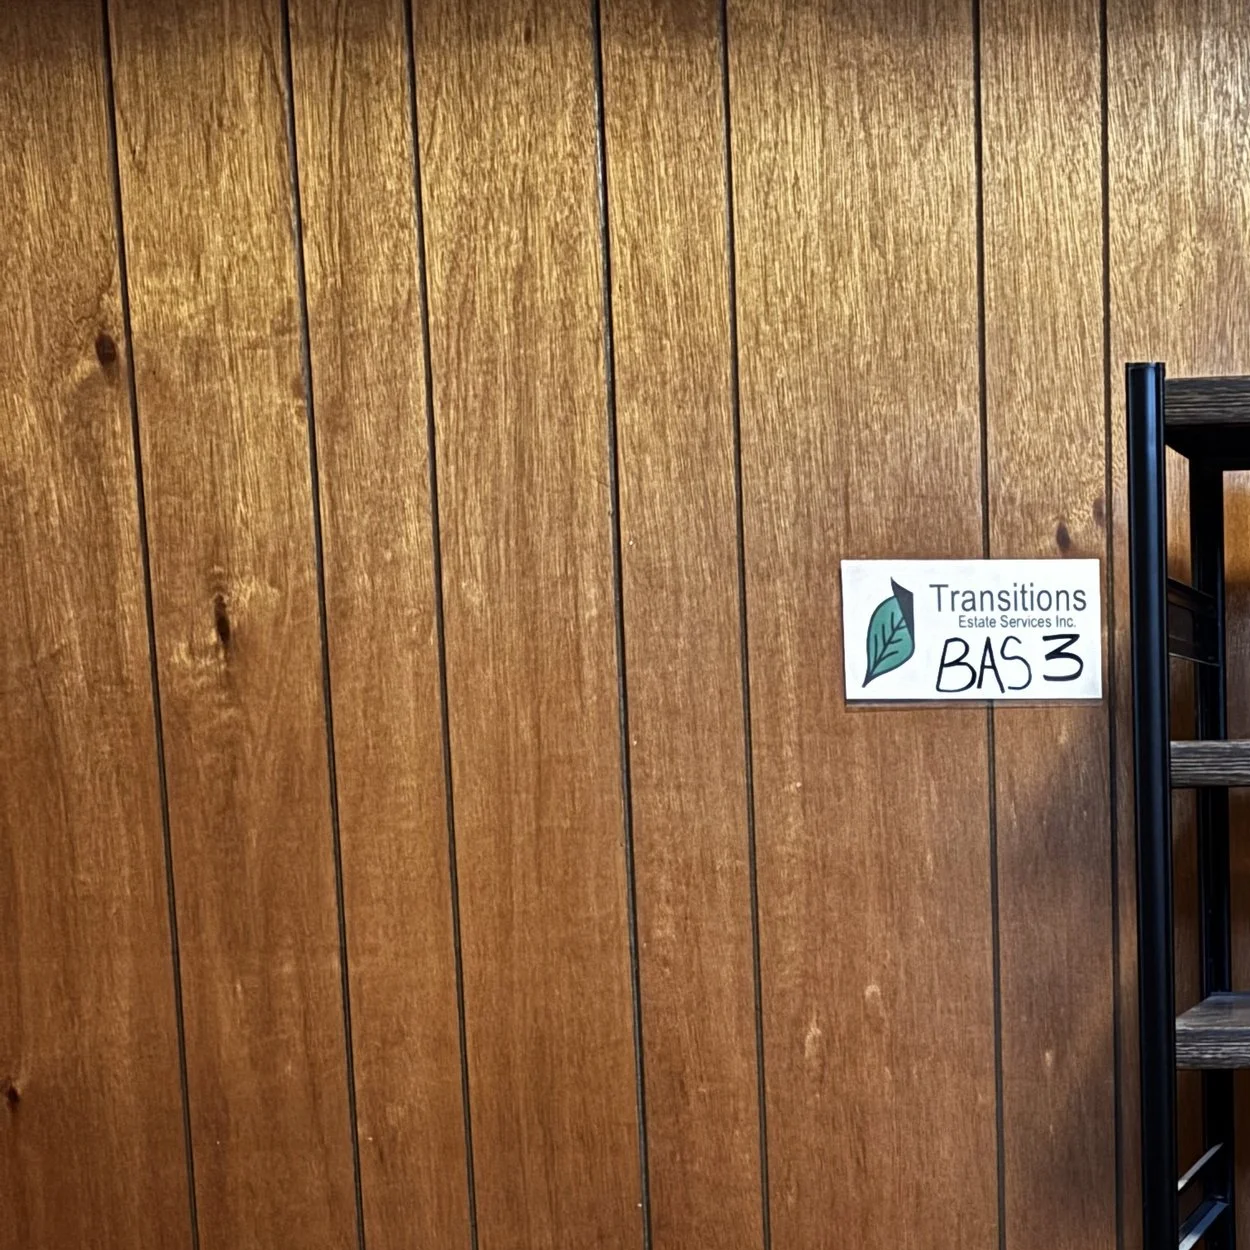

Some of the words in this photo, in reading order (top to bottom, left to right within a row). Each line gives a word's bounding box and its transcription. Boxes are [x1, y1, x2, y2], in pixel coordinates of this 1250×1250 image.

[929, 582, 1087, 612] Transitions
[958, 615, 997, 628] Estate
[1000, 615, 1052, 628] Services
[1055, 615, 1076, 628] Inc.
